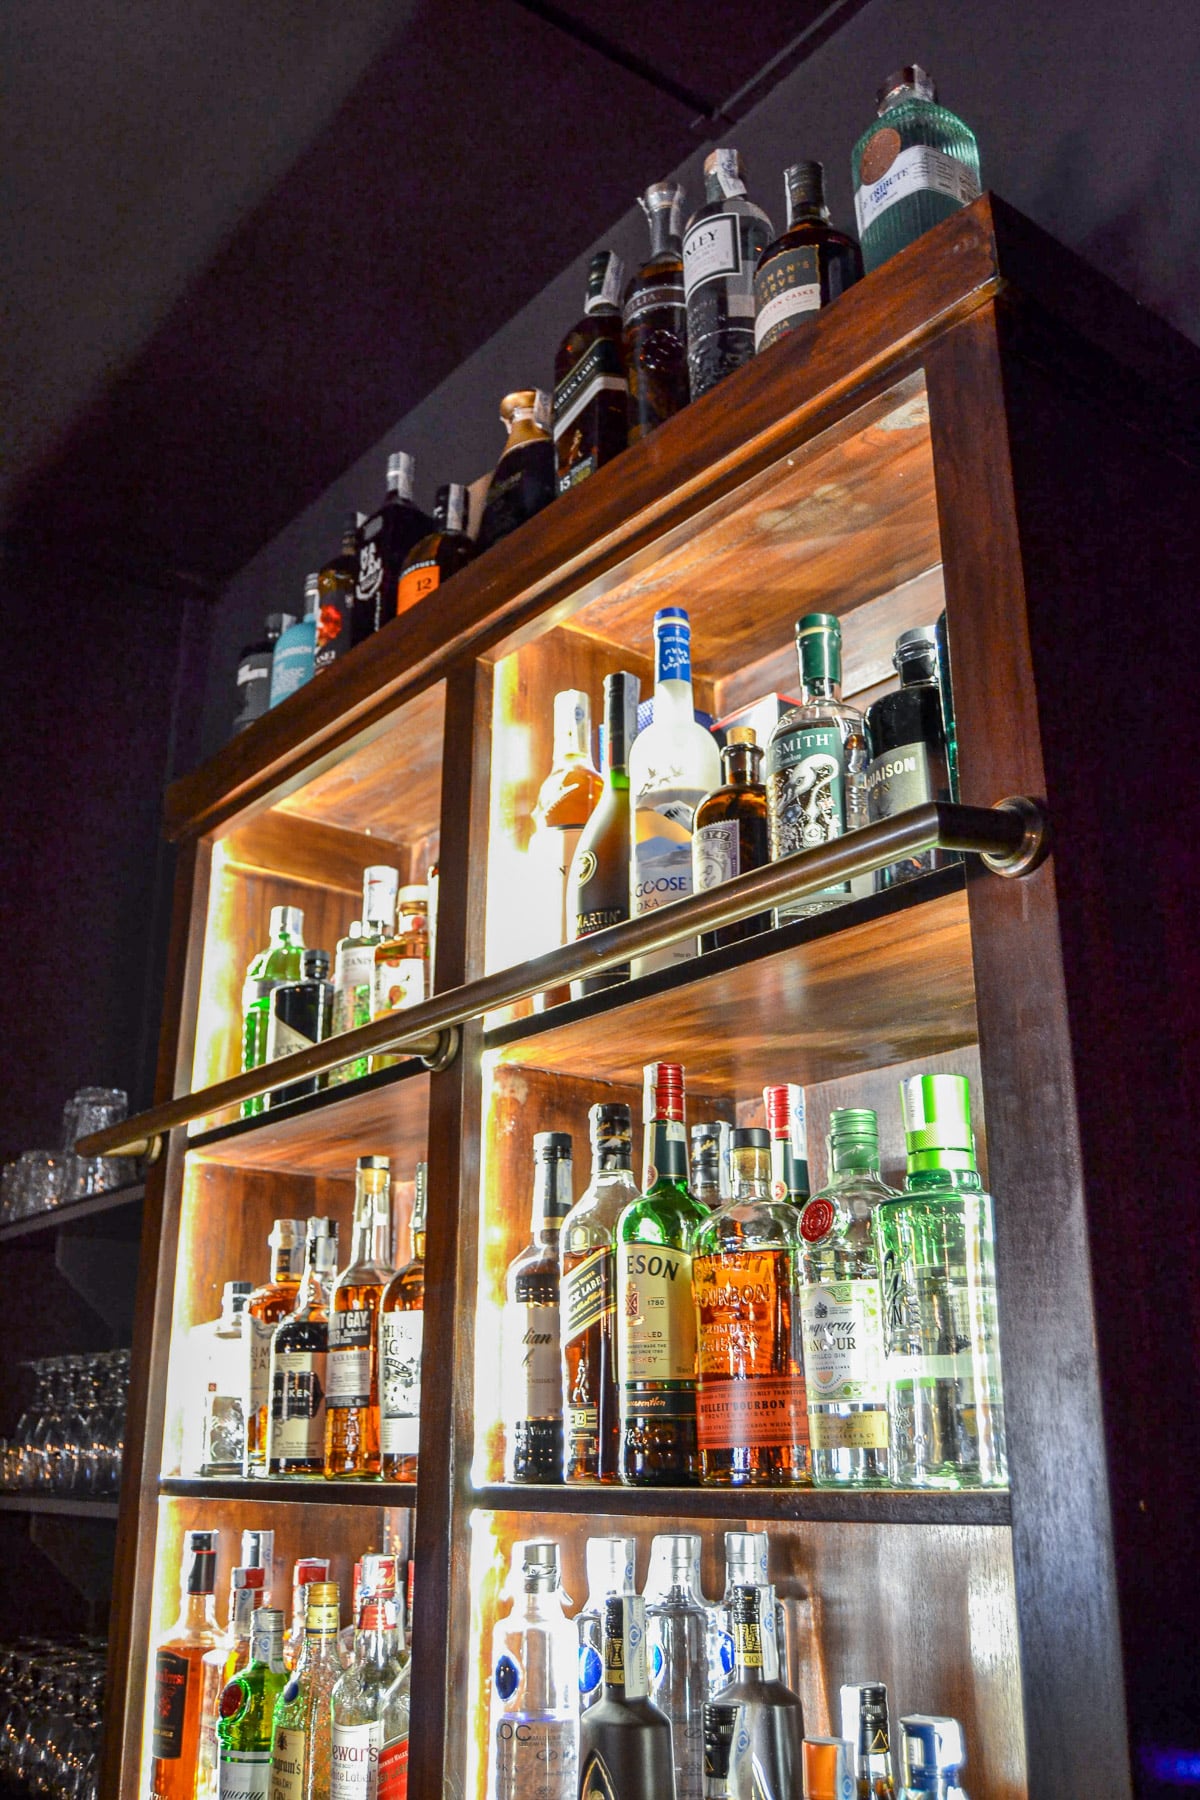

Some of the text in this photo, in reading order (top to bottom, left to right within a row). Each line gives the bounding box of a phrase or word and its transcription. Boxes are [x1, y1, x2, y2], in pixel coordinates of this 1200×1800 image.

[553, 355, 601, 409] GREEN LABEL
[559, 475, 571, 493] 15
[416, 577, 432, 592] 12
[775, 733, 833, 757] SMITH
[635, 876, 688, 899] GOOSE
[581, 1275, 608, 1297] LABEL
[346, 1310, 369, 1329] GAY
[732, 1400, 786, 1411] BOURBON
